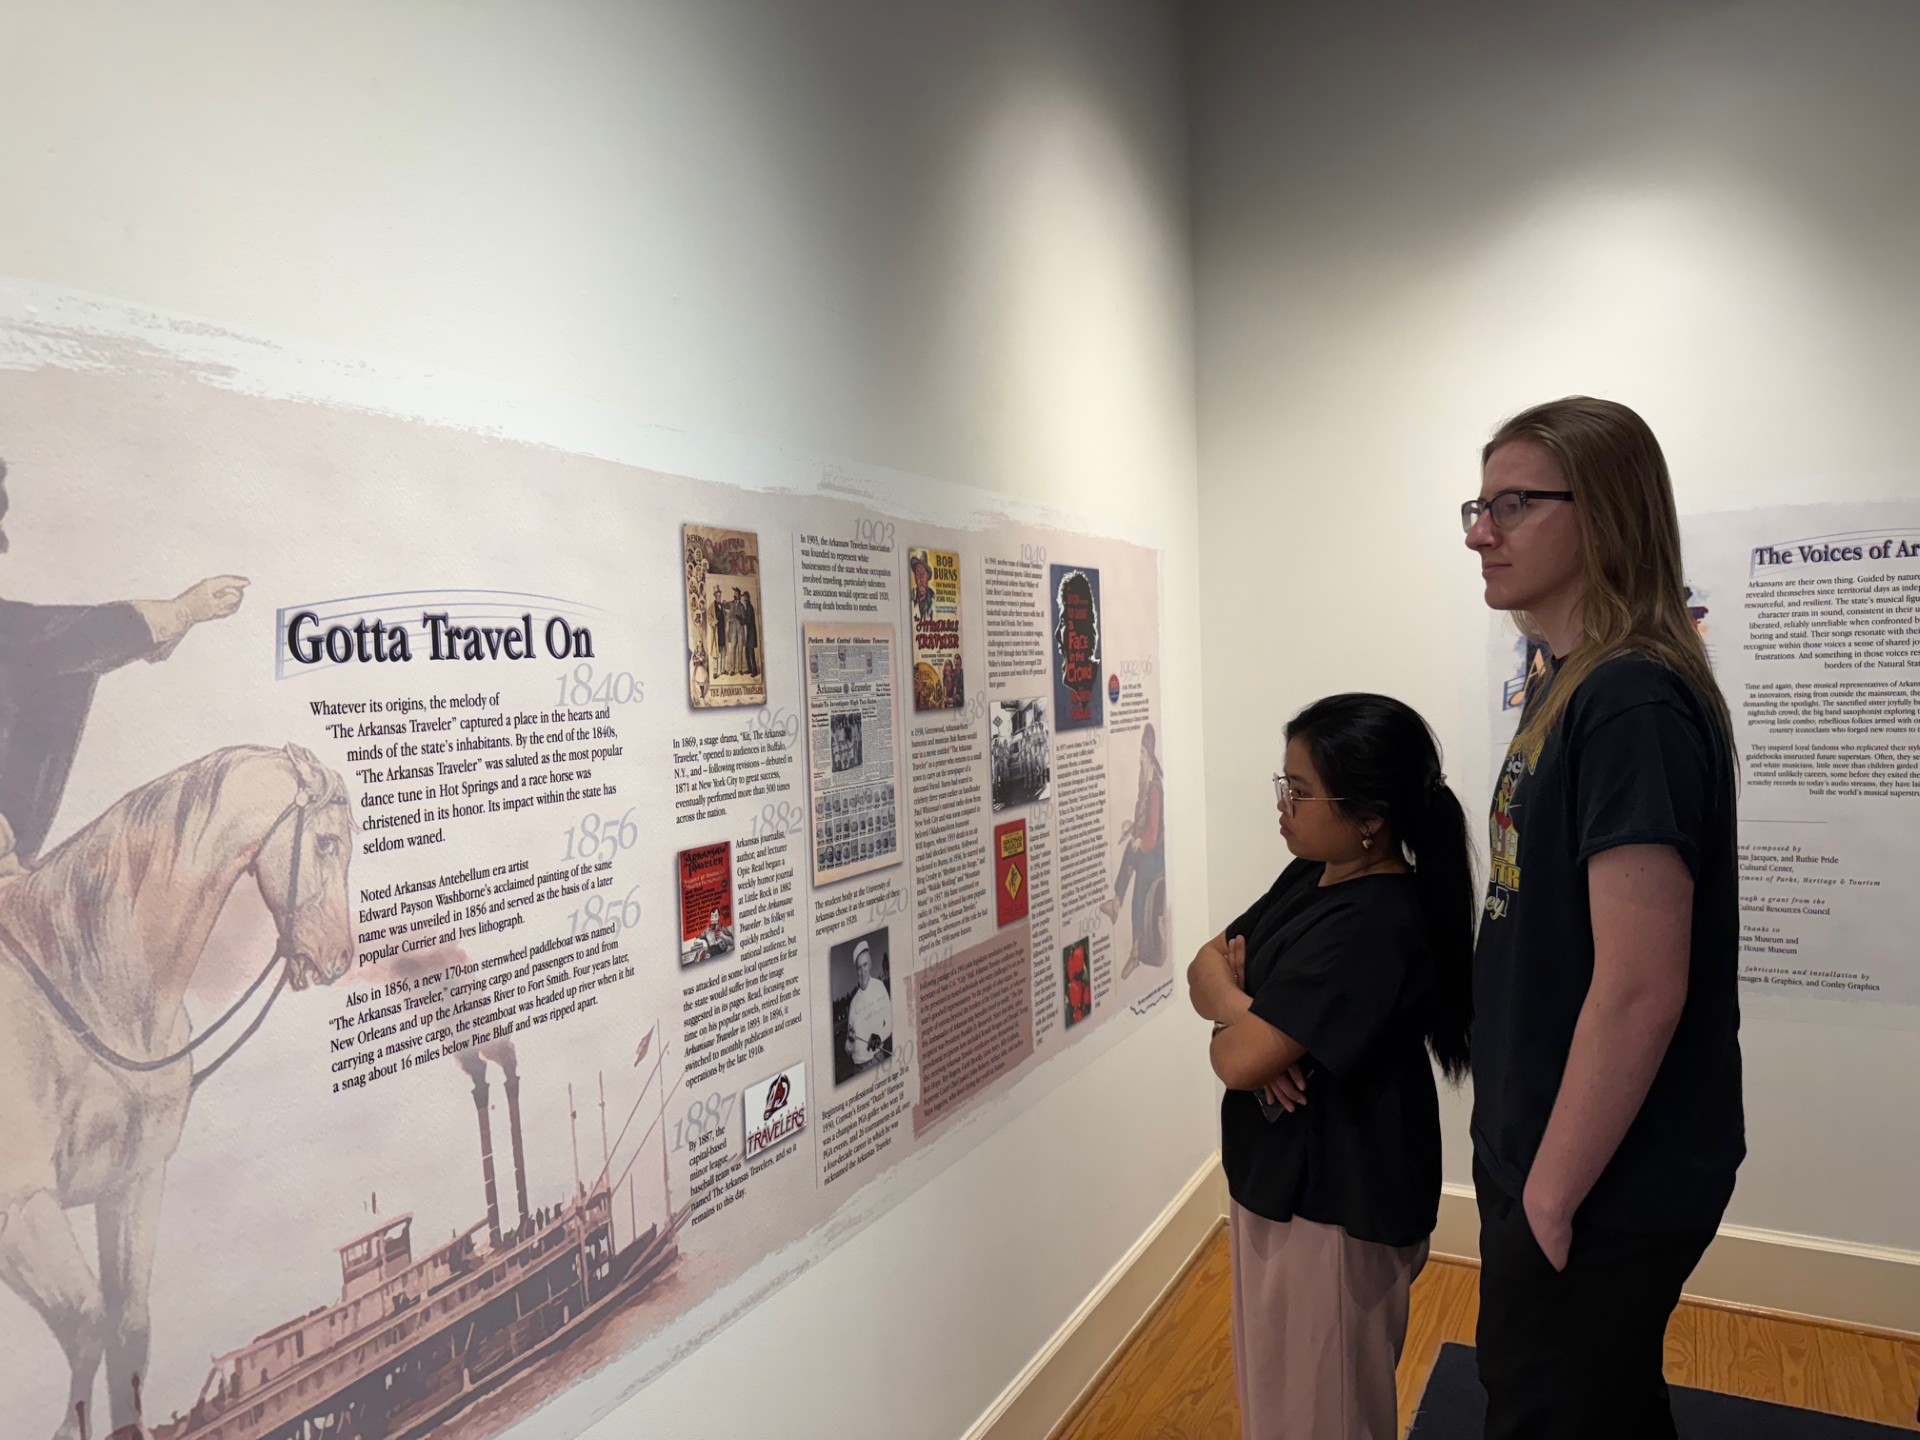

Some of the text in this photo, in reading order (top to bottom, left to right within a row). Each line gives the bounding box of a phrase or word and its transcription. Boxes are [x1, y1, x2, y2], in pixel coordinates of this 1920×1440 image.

[853, 517, 895, 553] 1903
[1754, 540, 1892, 565] The Voices of
[934, 568, 957, 581] BURNS
[936, 555, 954, 567] BOB
[1745, 590, 1776, 599] revealed
[1776, 588, 1816, 598] themselves
[1816, 588, 1836, 596] since
[1836, 583, 1872, 595] territorial
[1873, 584, 1891, 594] days
[1748, 580, 1784, 588] Arkansans
[1797, 578, 1816, 586] their
[1833, 576, 1856, 586] thing.
[1856, 574, 1885, 583] Guided
[1885, 573, 1896, 584] by
[288, 611, 595, 664] Gotta Travel On
[554, 663, 644, 707] 1840s
[310, 692, 500, 716] Whatever its origins, the melody of
[325, 706, 610, 739] “The Arkansas Traveler” captured a place in the hearts and
[672, 728, 786, 749] In 1869, a stage drama, “Kit, The Arkansas
[746, 707, 799, 749] 1869
[347, 726, 618, 762] minds of the state’s inhabitants. By the end of the 1840s,
[356, 744, 623, 784] “The Arkansas Traveler” was saluted as the most popular
[360, 769, 592, 808] dance tune in Hot Springs and a race horse was
[362, 783, 617, 831] christened in its honor. Its impact within the state has
[676, 807, 726, 824] across the nation.
[750, 801, 803, 837] 1882
[363, 827, 446, 855] seldom waned.
[560, 807, 639, 863] 1856
[360, 860, 529, 903] Noted Arkansas Antebellum era artist
[1769, 865, 1794, 873] Center,
[566, 884, 641, 937] 1856
[738, 881, 792, 906] at Little Rock in 1882
[359, 912, 526, 967] popular Currier and Ives lithograph.
[1737, 974, 1880, 992] Images & Graphics, and Conley Graphics
[671, 1092, 737, 1153] 1887
[748, 1107, 805, 1154] TRAVELERS
[692, 1188, 746, 1226] remains to this day.
